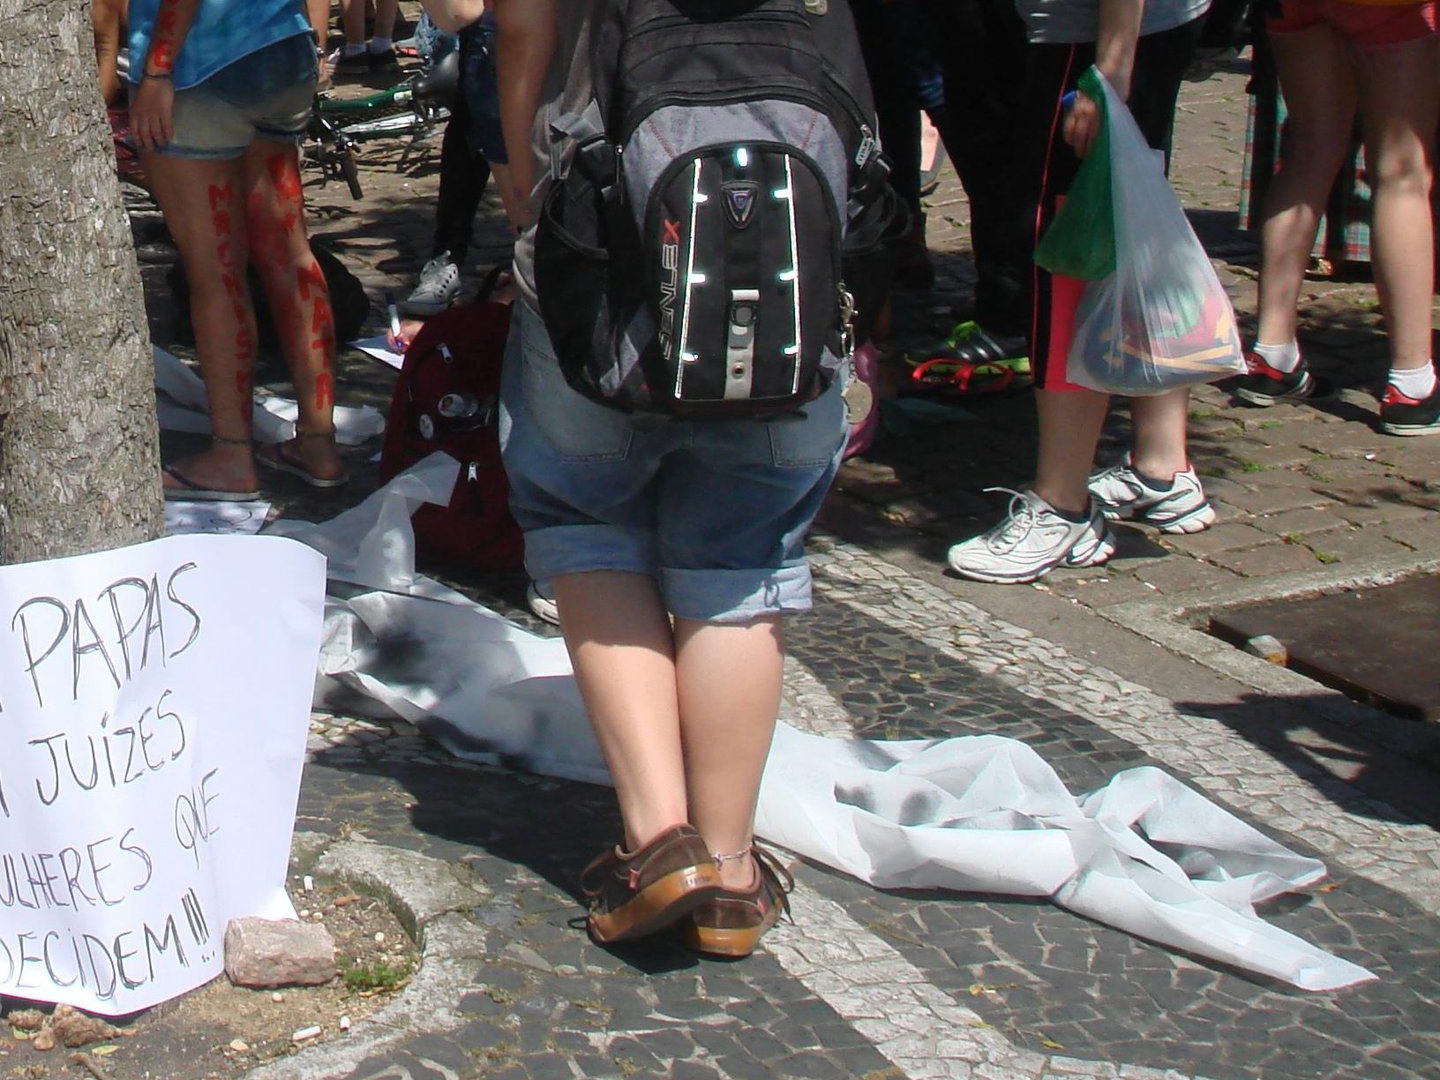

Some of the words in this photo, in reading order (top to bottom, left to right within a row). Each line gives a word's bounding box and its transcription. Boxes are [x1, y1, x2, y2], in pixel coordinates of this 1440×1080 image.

[297, 261, 335, 411] MATA
[12, 562, 201, 708] PAPAS
[28, 689, 187, 805] JUÍZES
[175, 768, 220, 870] QUE
